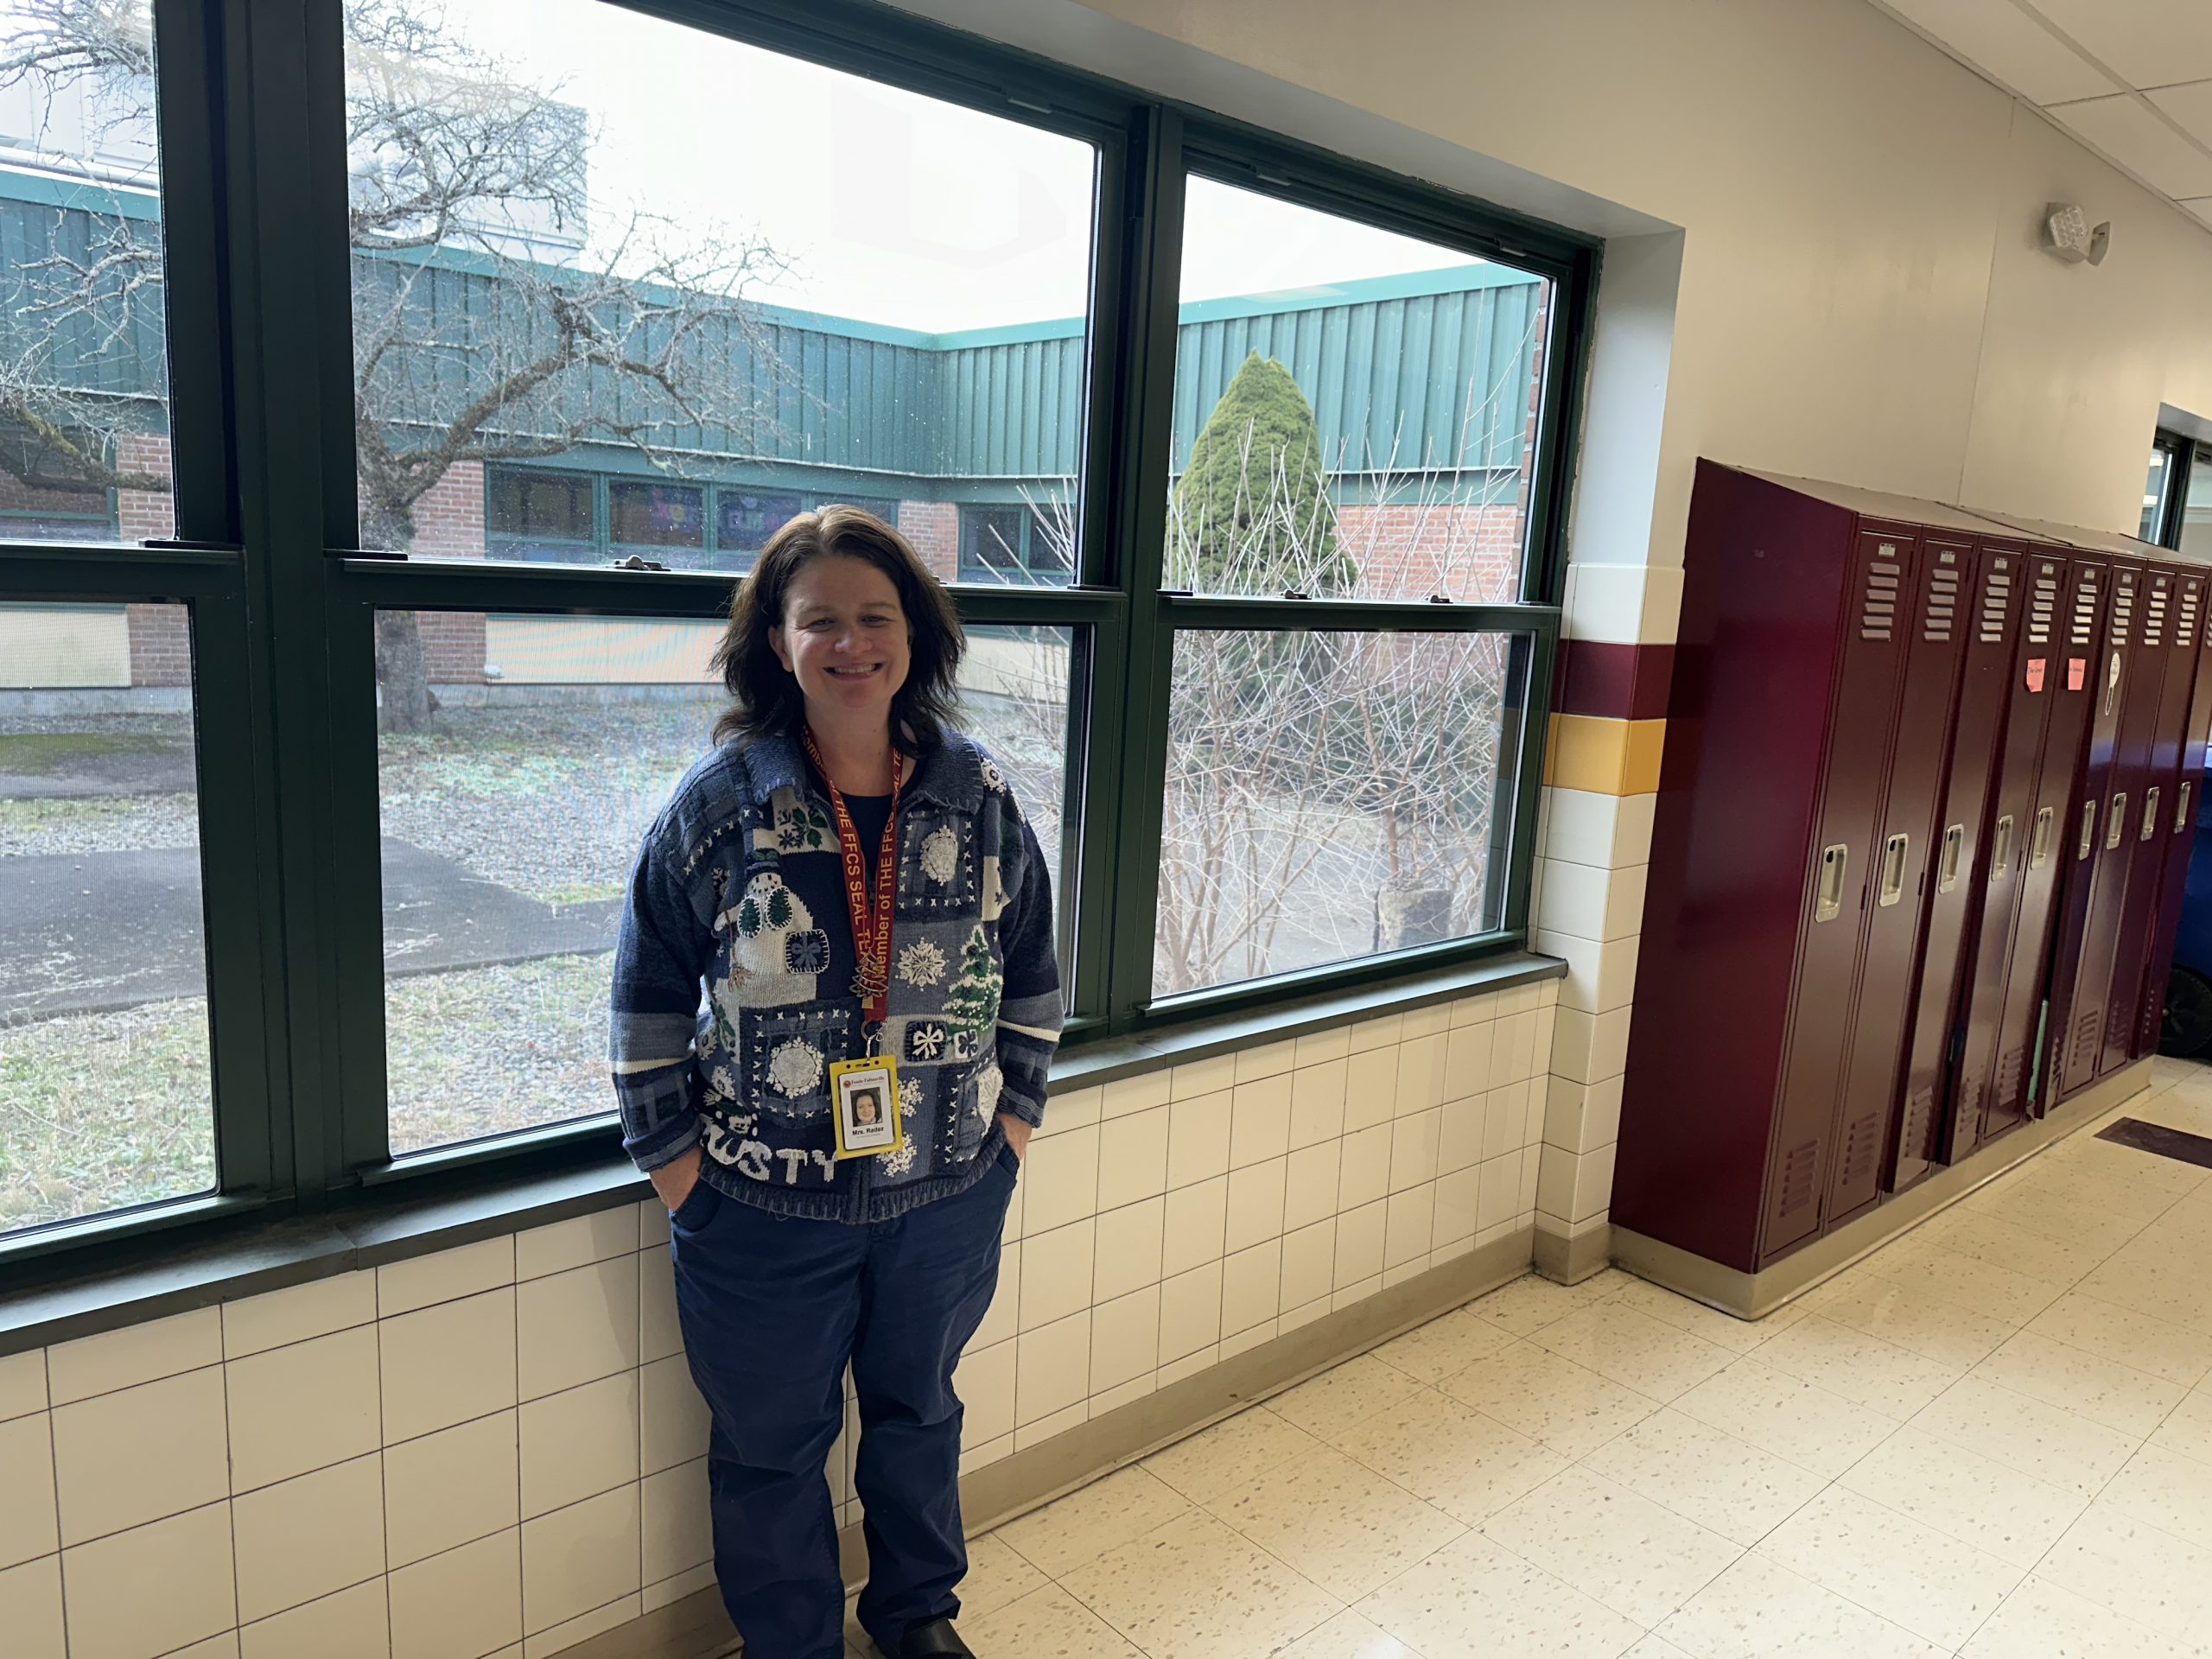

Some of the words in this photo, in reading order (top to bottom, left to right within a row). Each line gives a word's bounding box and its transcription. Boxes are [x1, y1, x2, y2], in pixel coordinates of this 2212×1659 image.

[836, 798, 852, 828] THE
[881, 811, 894, 853] FFCS
[843, 833, 861, 875] FFCS
[880, 856, 893, 891] THE
[849, 880, 867, 925] SEAL
[879, 893, 891, 910] of
